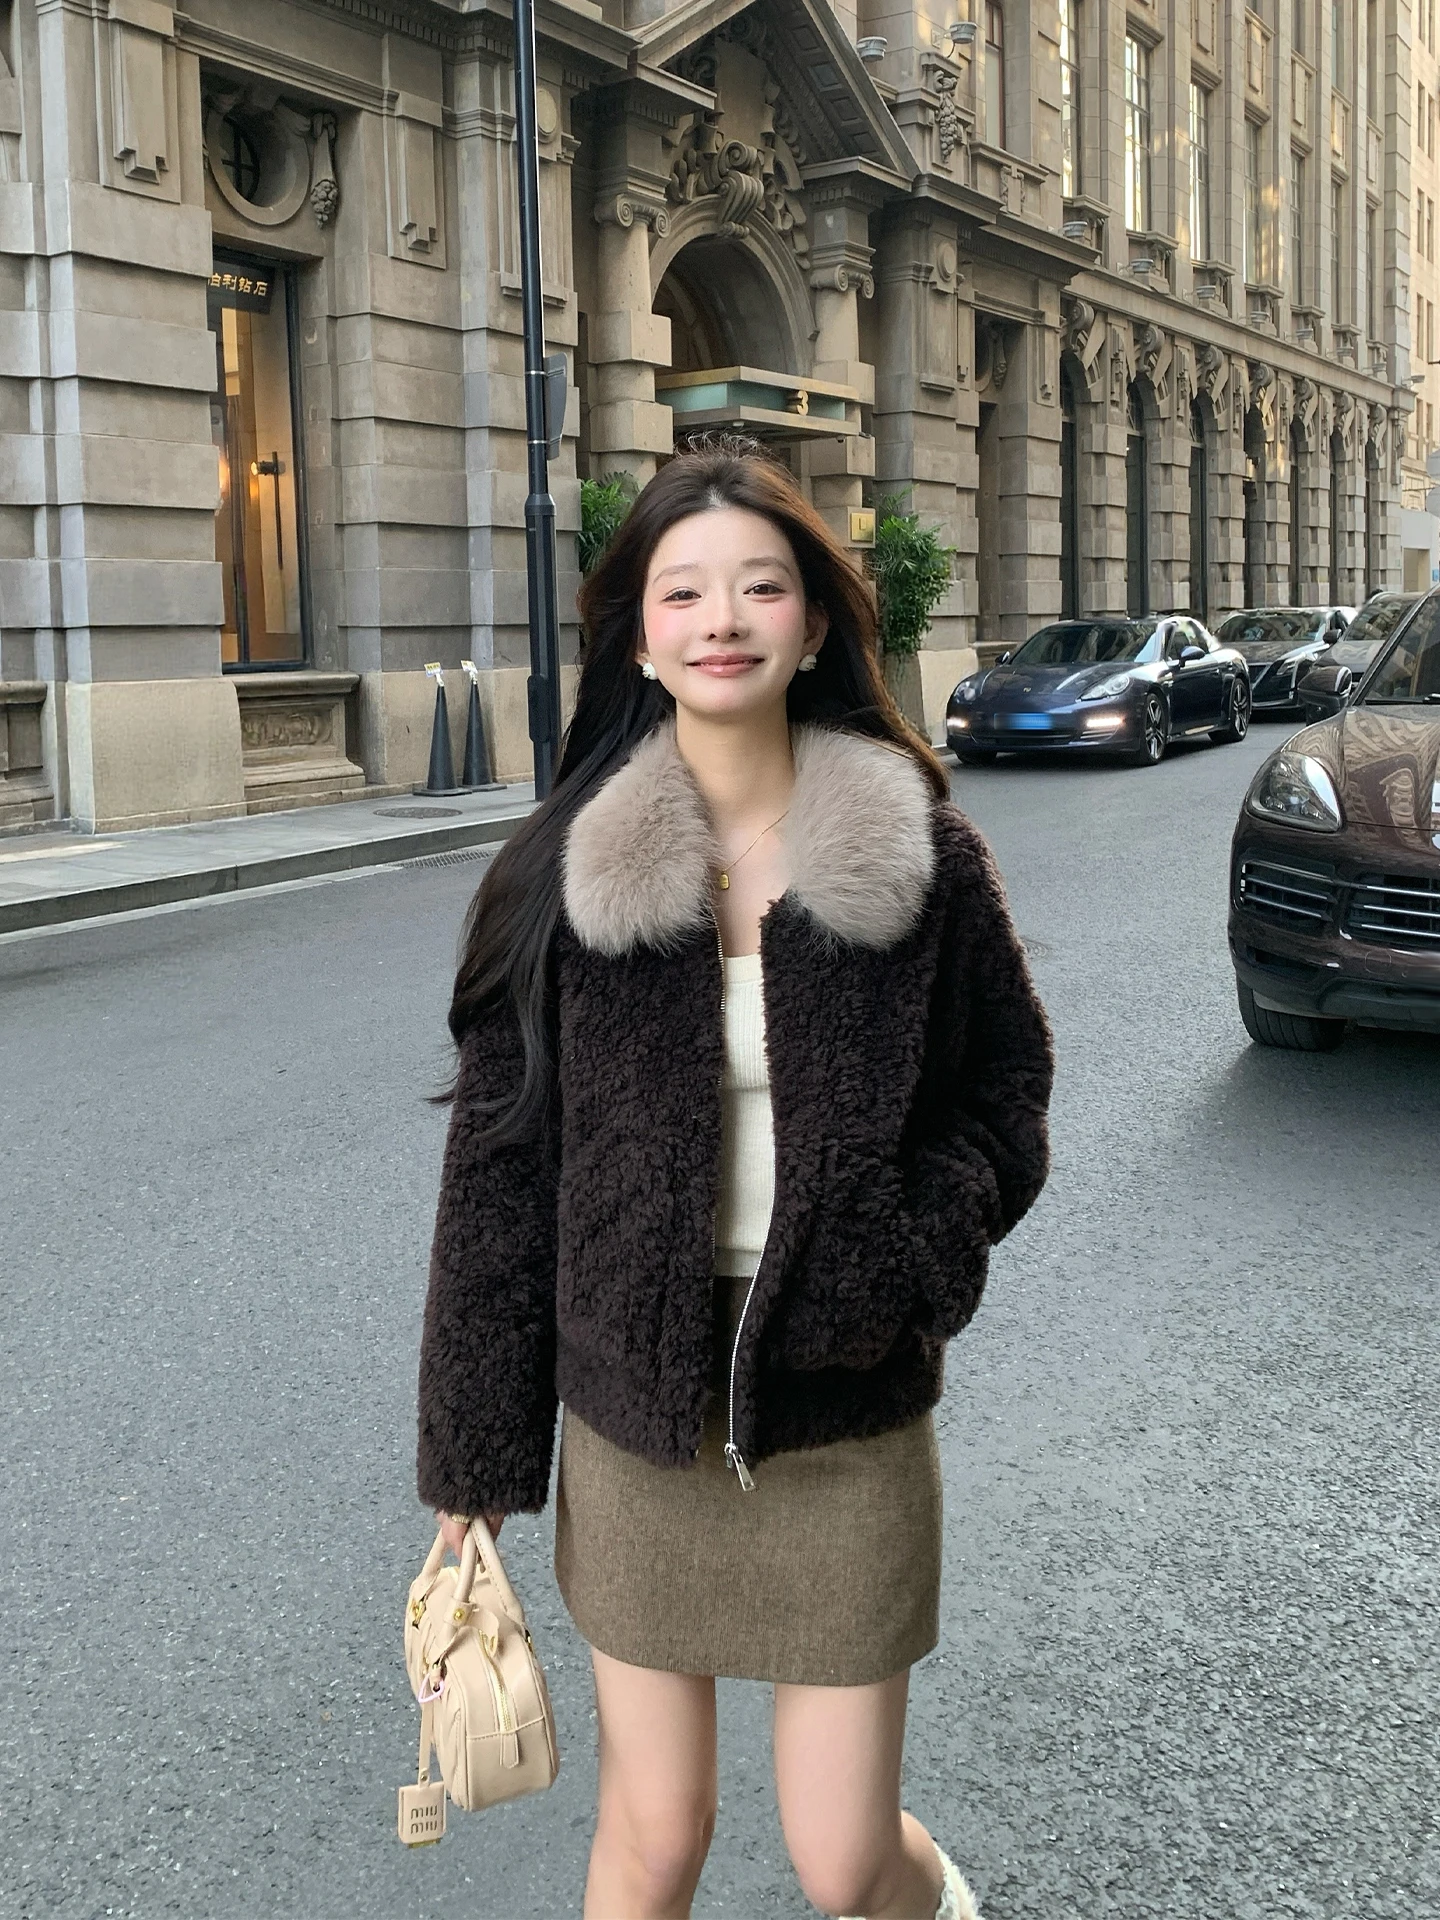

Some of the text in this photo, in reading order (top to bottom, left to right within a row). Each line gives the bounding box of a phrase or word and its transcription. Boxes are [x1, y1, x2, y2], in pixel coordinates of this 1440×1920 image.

[795, 390, 809, 416] 3
[410, 1805, 438, 1820] miu
[410, 1820, 438, 1835] miu
